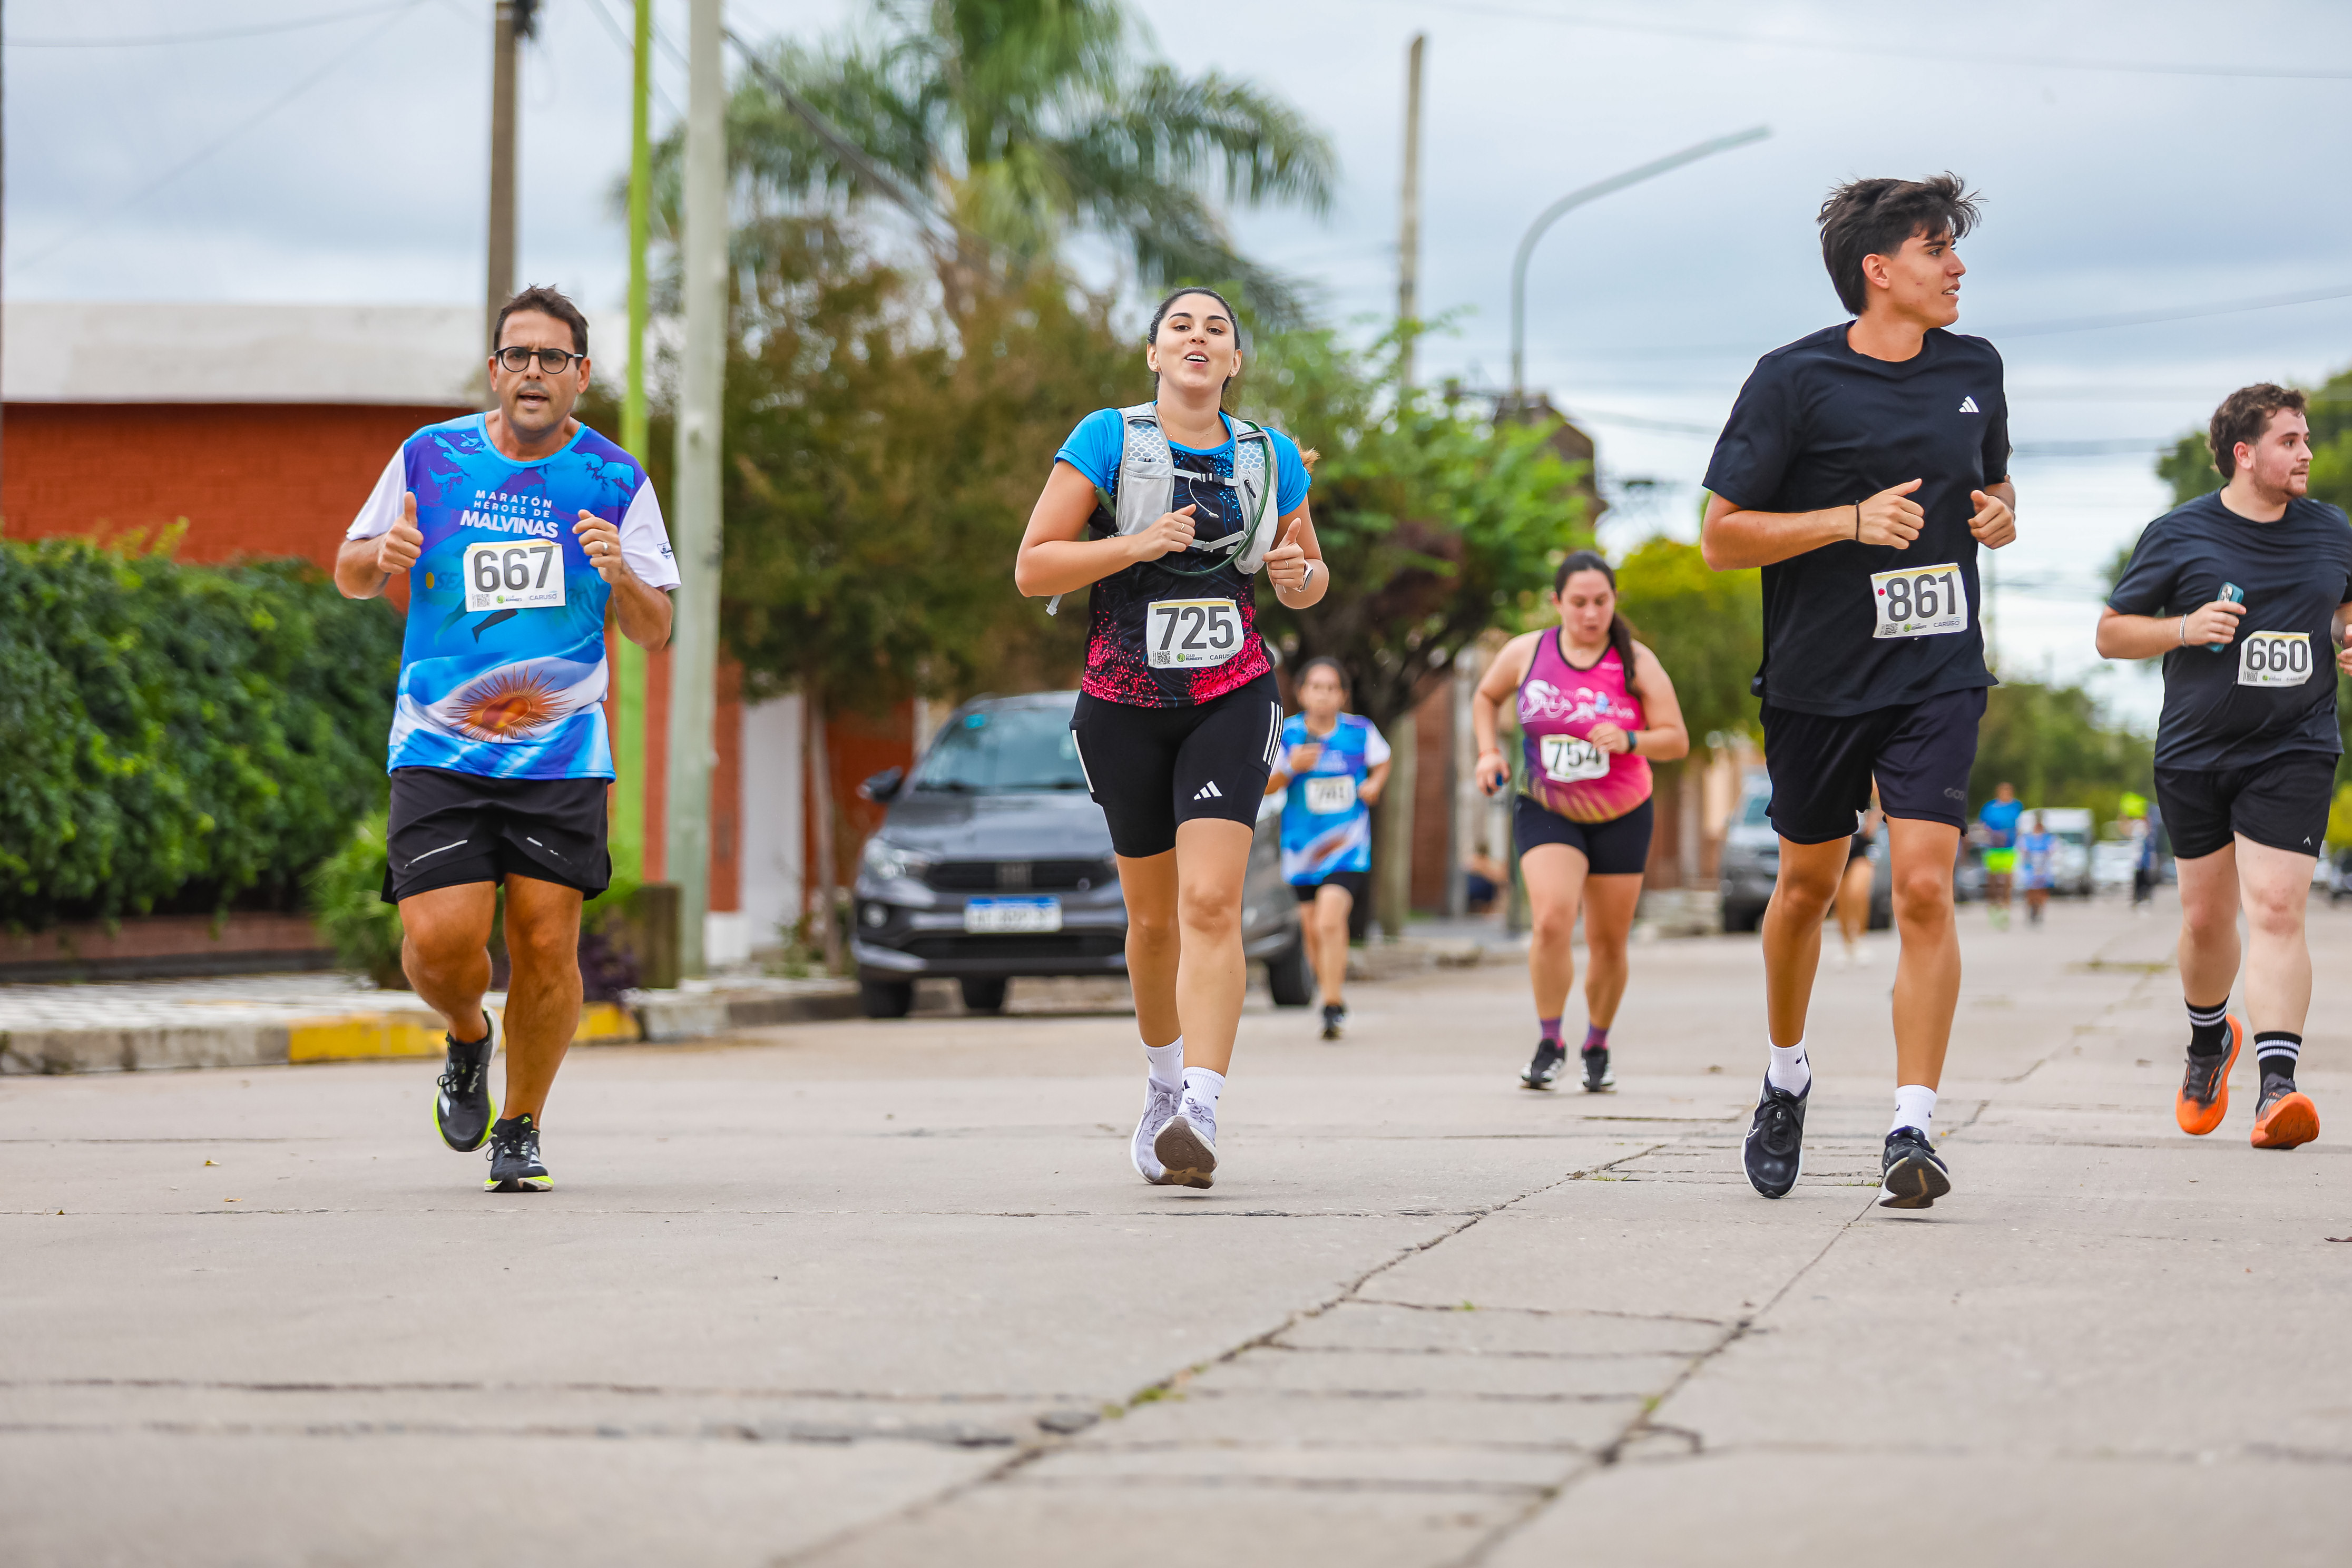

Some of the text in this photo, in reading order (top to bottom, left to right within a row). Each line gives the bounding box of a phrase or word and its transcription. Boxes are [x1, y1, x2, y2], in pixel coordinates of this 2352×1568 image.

[474, 501, 551, 518] HÉROES DE
[475, 489, 552, 508] MARATÓN
[460, 509, 558, 538] MALVINAS
[474, 546, 554, 593] 667
[1886, 571, 1956, 622] 861
[1156, 606, 1234, 650] 725
[2246, 638, 2308, 672] 660
[1549, 741, 1600, 772] 754
